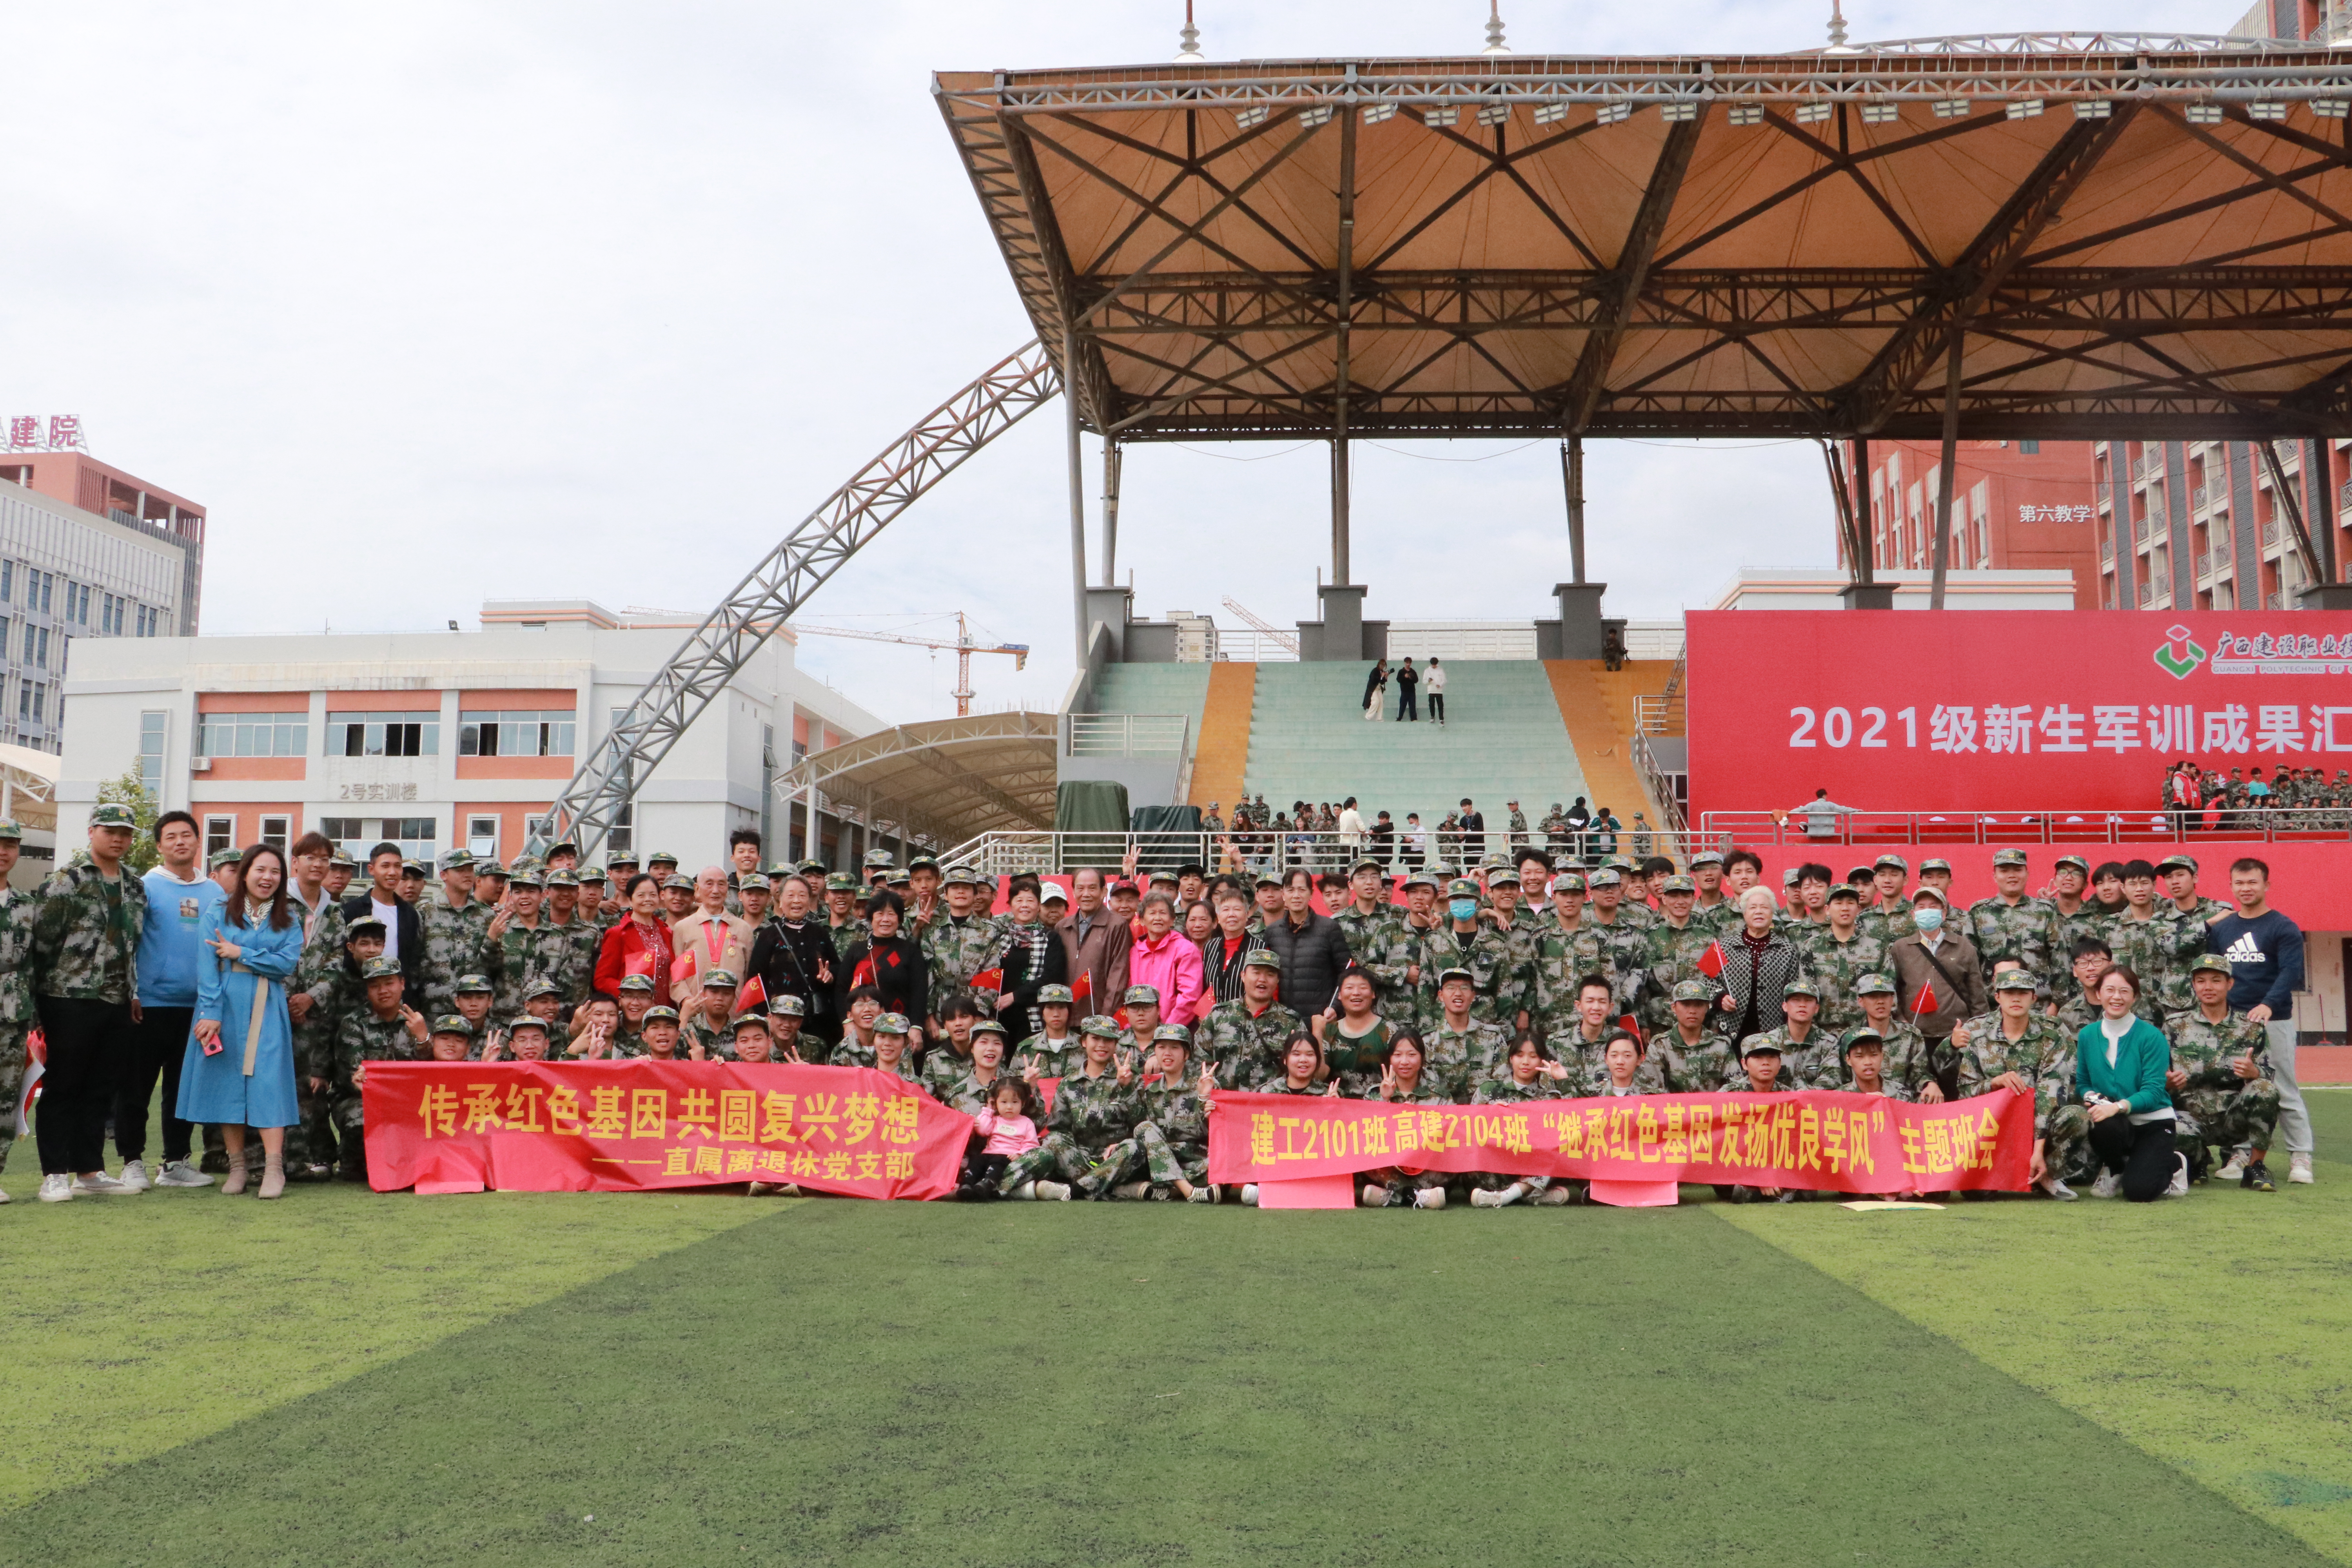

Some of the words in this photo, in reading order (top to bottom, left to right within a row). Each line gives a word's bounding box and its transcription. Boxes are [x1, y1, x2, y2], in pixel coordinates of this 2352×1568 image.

[10, 416, 77, 448] 建院
[2019, 505, 2094, 523] 第六教学
[1789, 704, 2352, 754] 2021级新生军训成果汇
[340, 782, 417, 800] 2号实训楼
[2224, 951, 2266, 962] adidas
[1899, 1107, 2000, 1176] 主题班会
